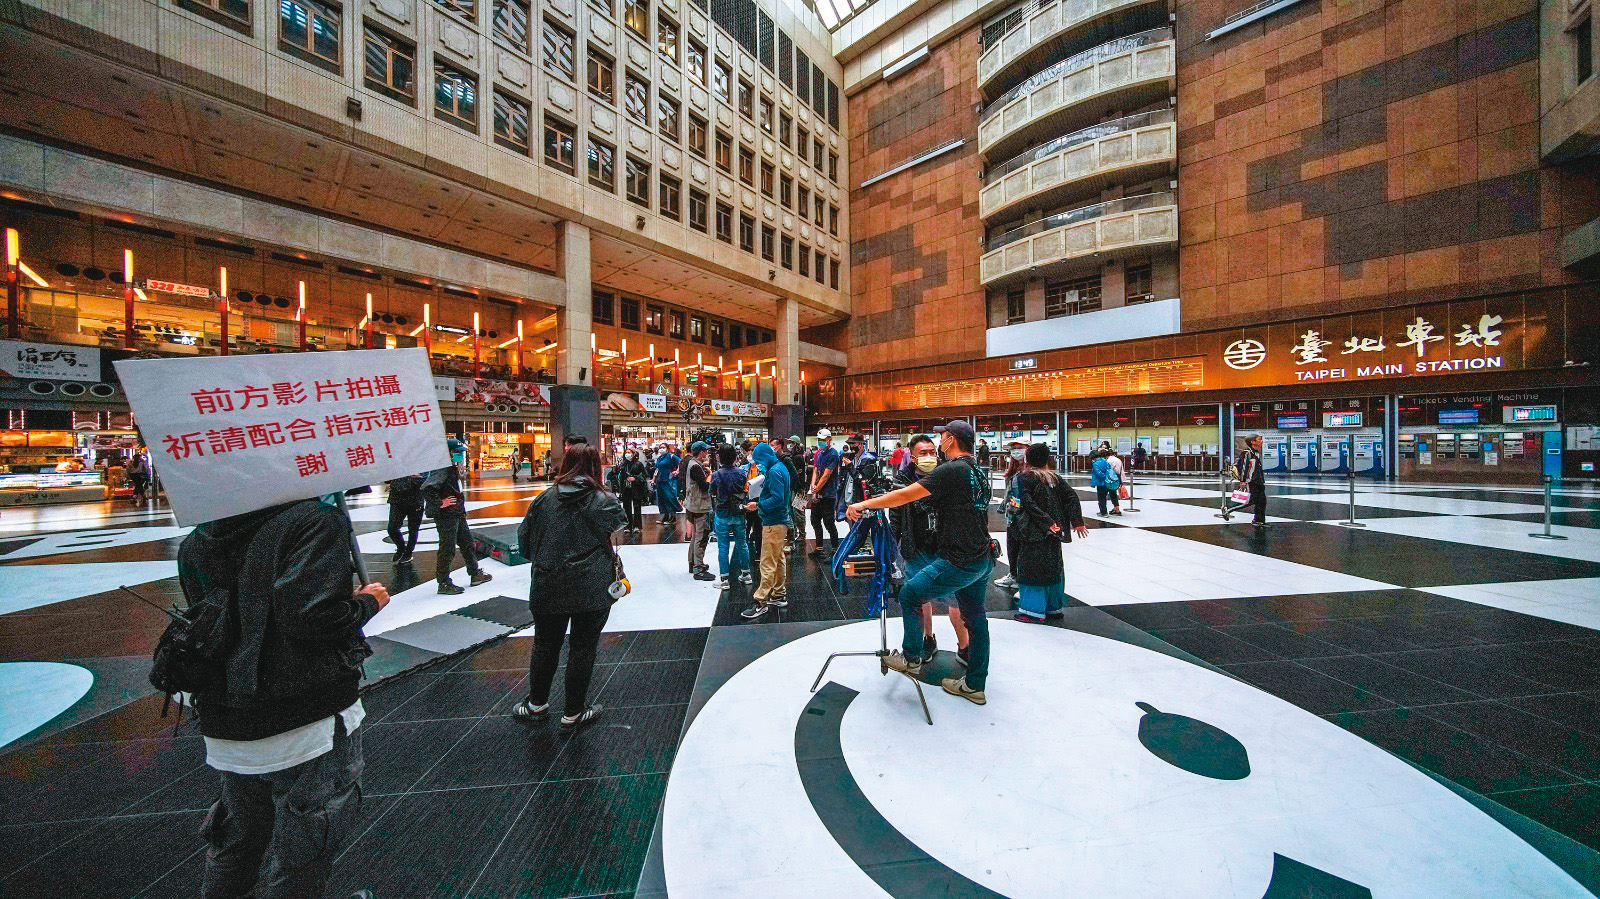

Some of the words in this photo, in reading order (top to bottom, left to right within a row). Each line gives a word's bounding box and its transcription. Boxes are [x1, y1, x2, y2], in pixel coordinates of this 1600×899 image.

[1291, 314, 1504, 365] 臺北車站
[1295, 369, 1346, 381] TAIPEI
[1357, 364, 1403, 377] MAIN
[1415, 357, 1503, 373] STATION
[191, 374, 402, 415] 前方影片拍攝
[1412, 397, 1448, 405] Tickets
[1453, 395, 1491, 404] Vending
[1497, 392, 1540, 401] Machine
[162, 403, 432, 461] 祈請配合指示通行
